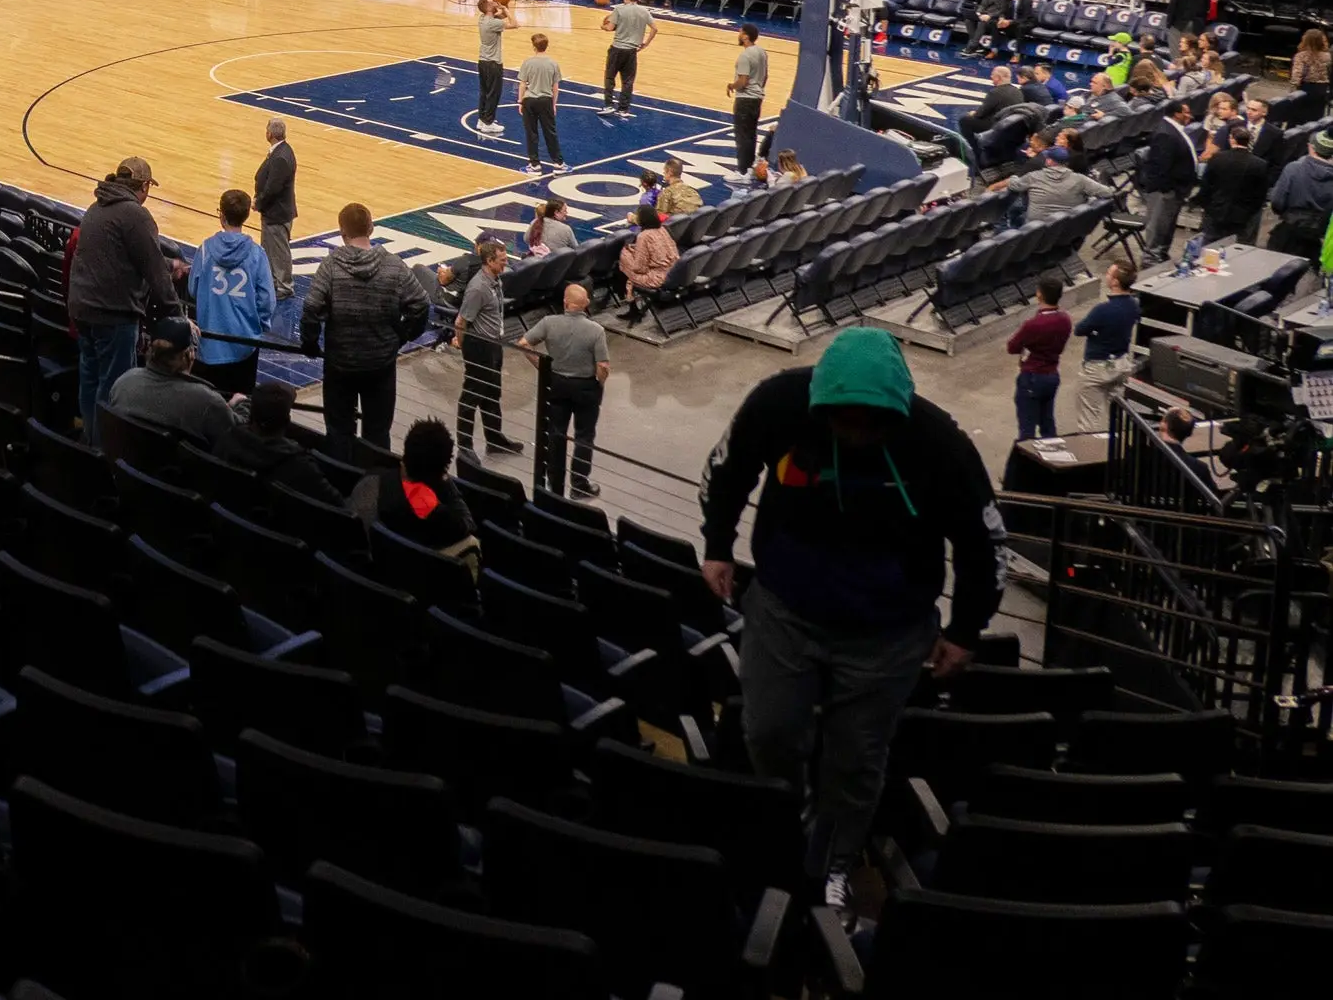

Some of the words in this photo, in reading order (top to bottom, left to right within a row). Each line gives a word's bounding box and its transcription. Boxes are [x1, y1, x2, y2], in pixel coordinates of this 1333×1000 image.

[1054, 1, 1067, 13] G
[1084, 6, 1098, 18] G
[1117, 10, 1130, 23] G
[1149, 14, 1163, 26] G
[900, 25, 914, 37] G
[928, 29, 943, 42] G
[1215, 25, 1229, 36] G
[979, 34, 993, 47] G
[1035, 44, 1051, 56] G
[1066, 48, 1082, 61] G
[211, 266, 248, 298] 32
